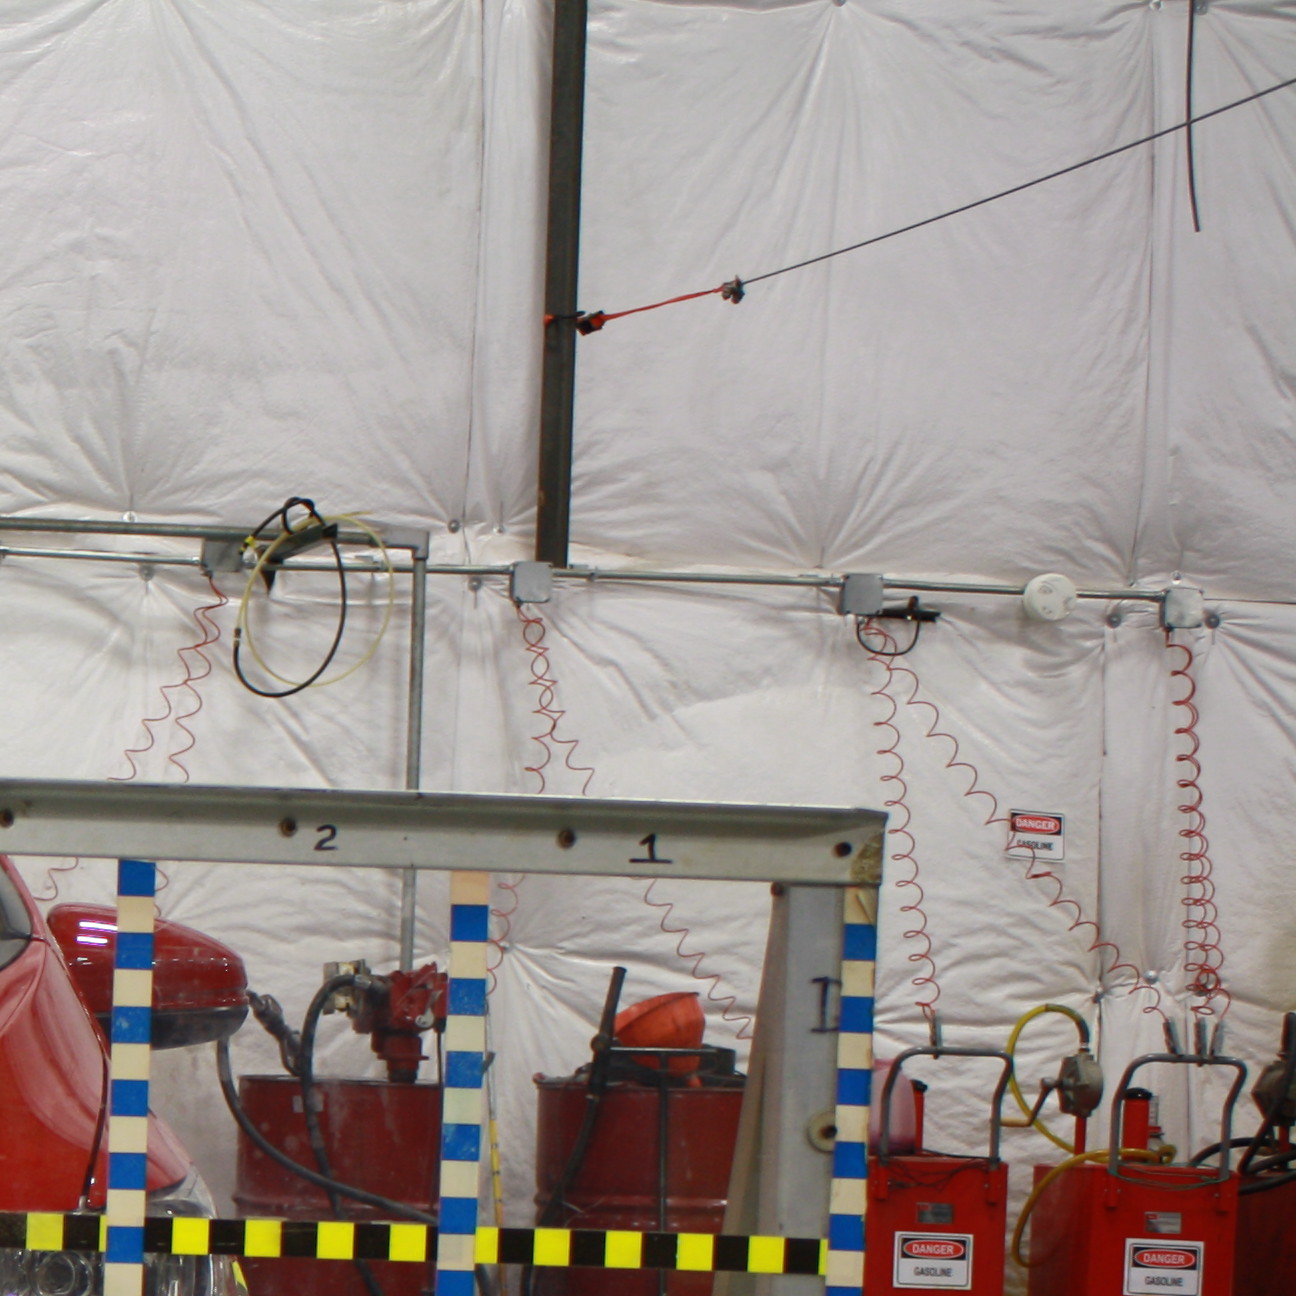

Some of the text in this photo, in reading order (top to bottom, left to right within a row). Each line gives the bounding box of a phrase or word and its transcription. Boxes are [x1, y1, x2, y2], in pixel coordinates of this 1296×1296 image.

[314, 824, 339, 852] 2
[628, 833, 673, 864] 1
[911, 1243, 955, 1255] DANGER
[1143, 1252, 1186, 1265] DANGER
[913, 1266, 953, 1278] GASOLINE
[1144, 1275, 1184, 1287] GASOLINE
